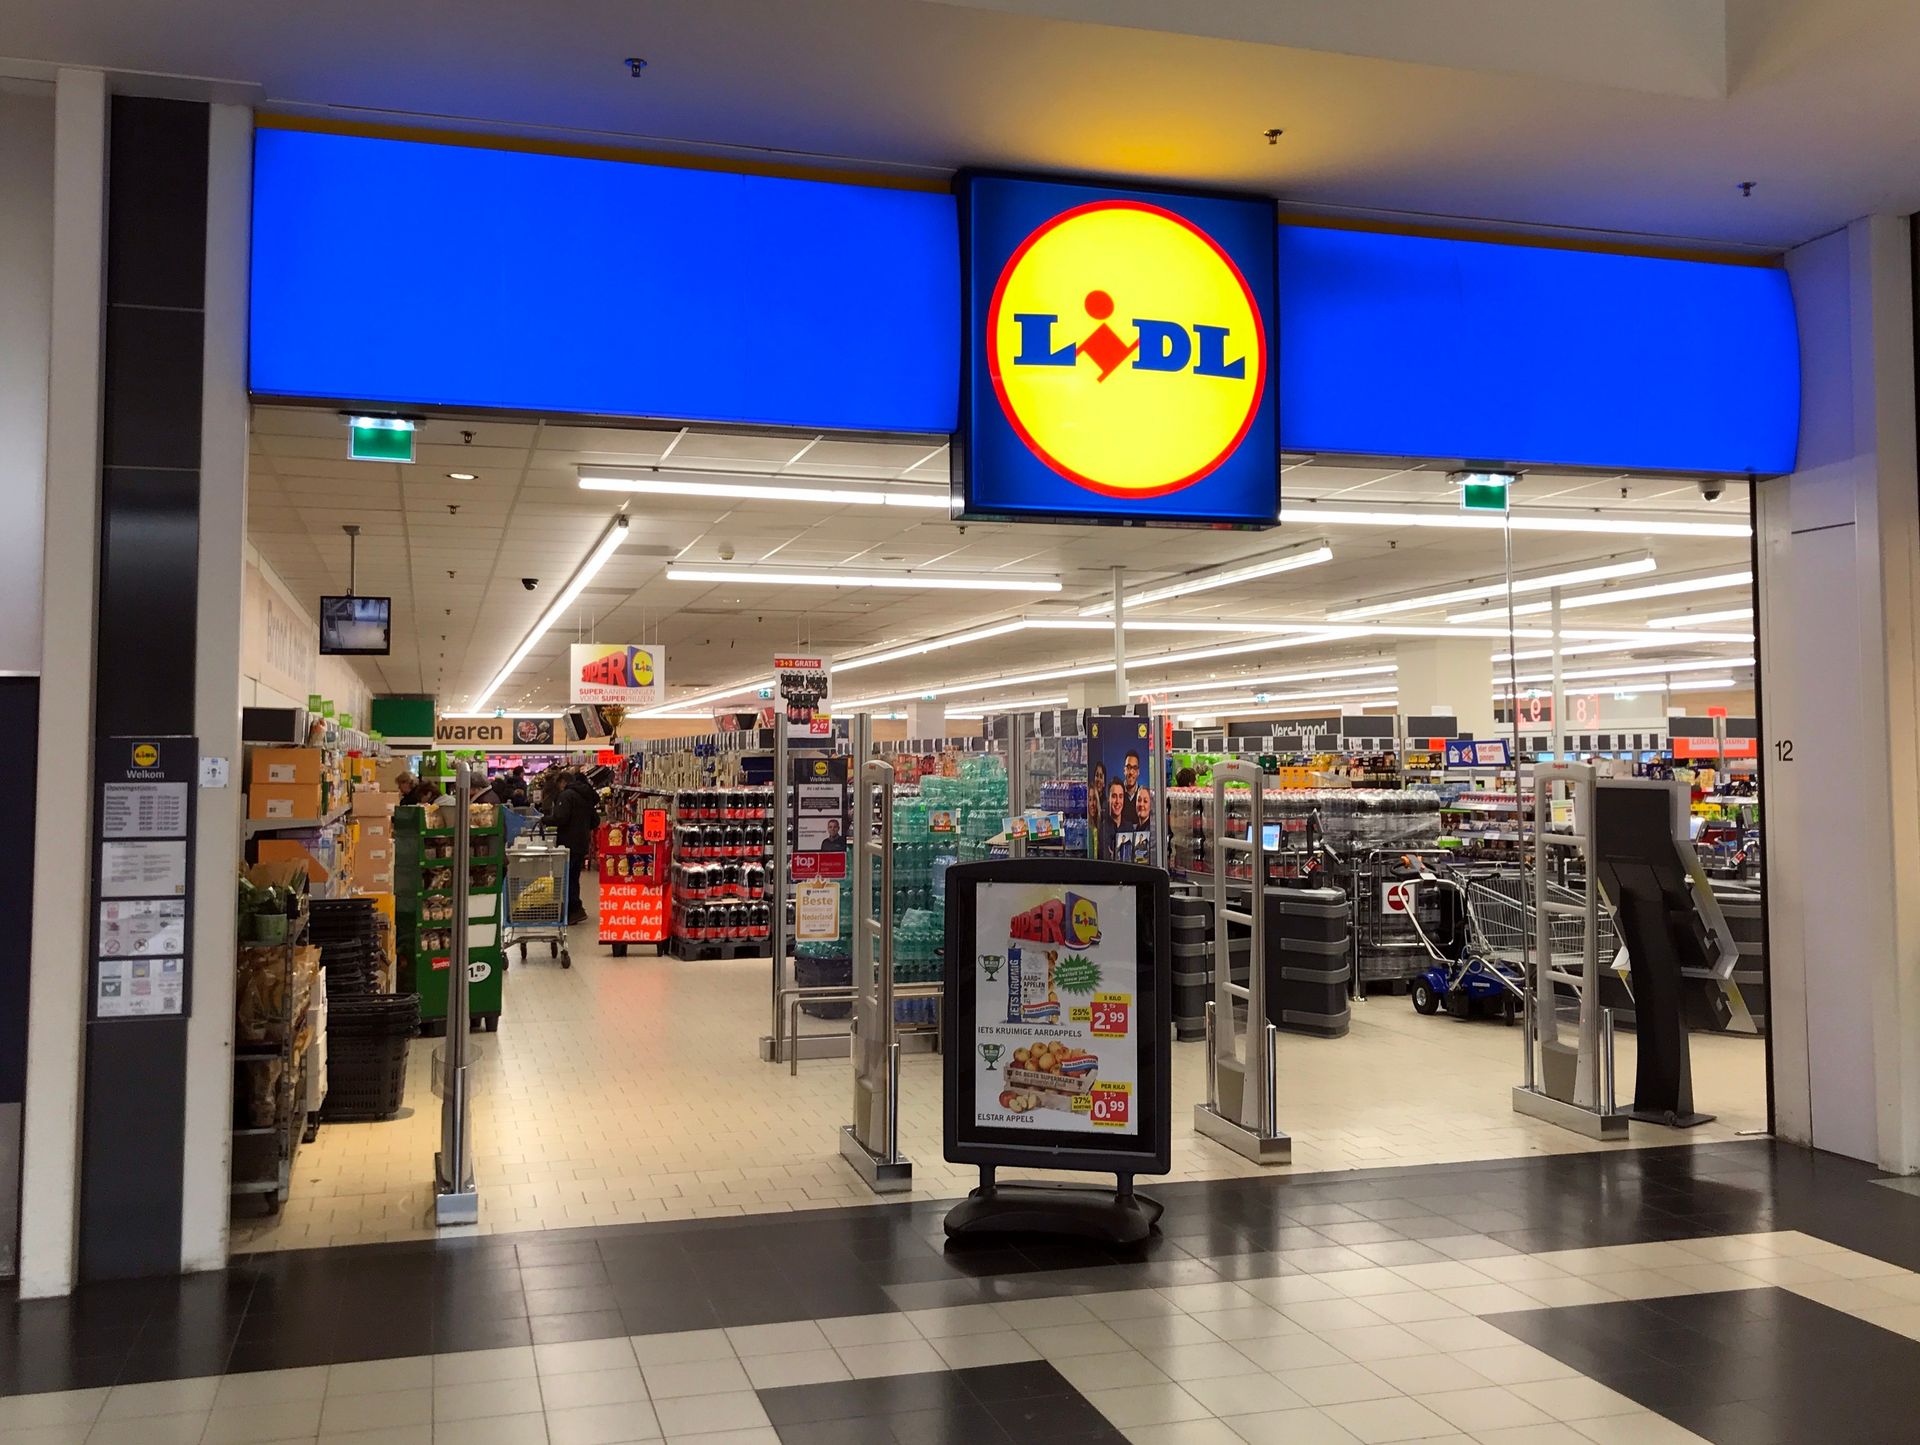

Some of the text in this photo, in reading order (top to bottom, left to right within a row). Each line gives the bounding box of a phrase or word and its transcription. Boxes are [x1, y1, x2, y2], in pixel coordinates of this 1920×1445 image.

[1014, 290, 1245, 383] LIDL
[581, 651, 628, 687] SUPER
[1775, 740, 1793, 762] 12
[126, 769, 165, 779] Welkom
[794, 855, 815, 868] top
[609, 886, 637, 896] Actie
[622, 900, 651, 910] Actie
[803, 896, 834, 905] Beste
[608, 915, 637, 925] Actie
[1009, 898, 1066, 946] SUPER
[622, 930, 651, 940] Actie
[1072, 1008, 1090, 1016] 25%
[1094, 1012, 1125, 1030] 2.99
[978, 1026, 1082, 1038] IETS KRUIMIGE AARDAPPELS
[1073, 1096, 1091, 1104] 37%
[1094, 1100, 1125, 1119] 0.99
[977, 1113, 1034, 1123] ELSTAR APPELS
